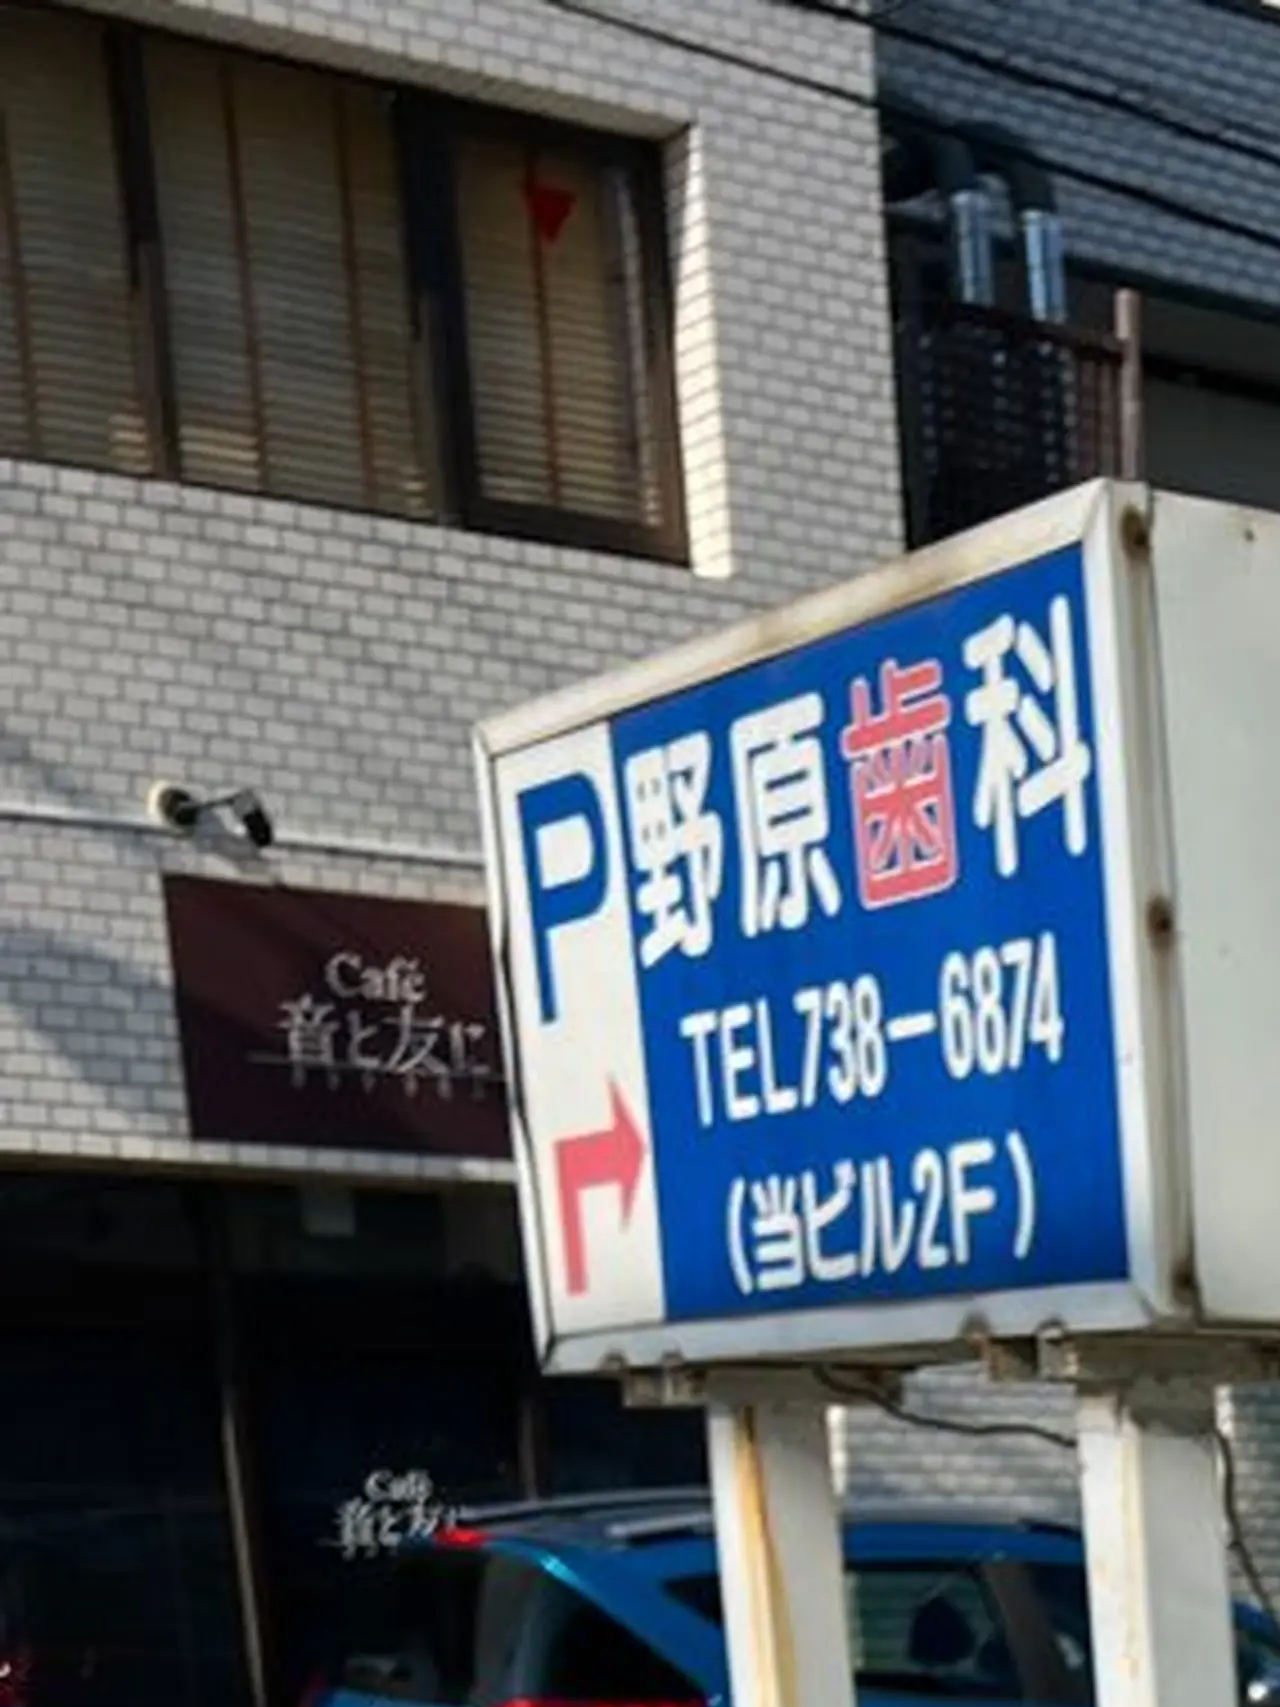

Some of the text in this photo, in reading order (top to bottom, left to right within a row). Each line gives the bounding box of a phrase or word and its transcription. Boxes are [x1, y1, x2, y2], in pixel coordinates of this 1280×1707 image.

[514, 768, 608, 1025] P
[624, 594, 1092, 968] 野原歯科
[326, 952, 427, 1002] Café
